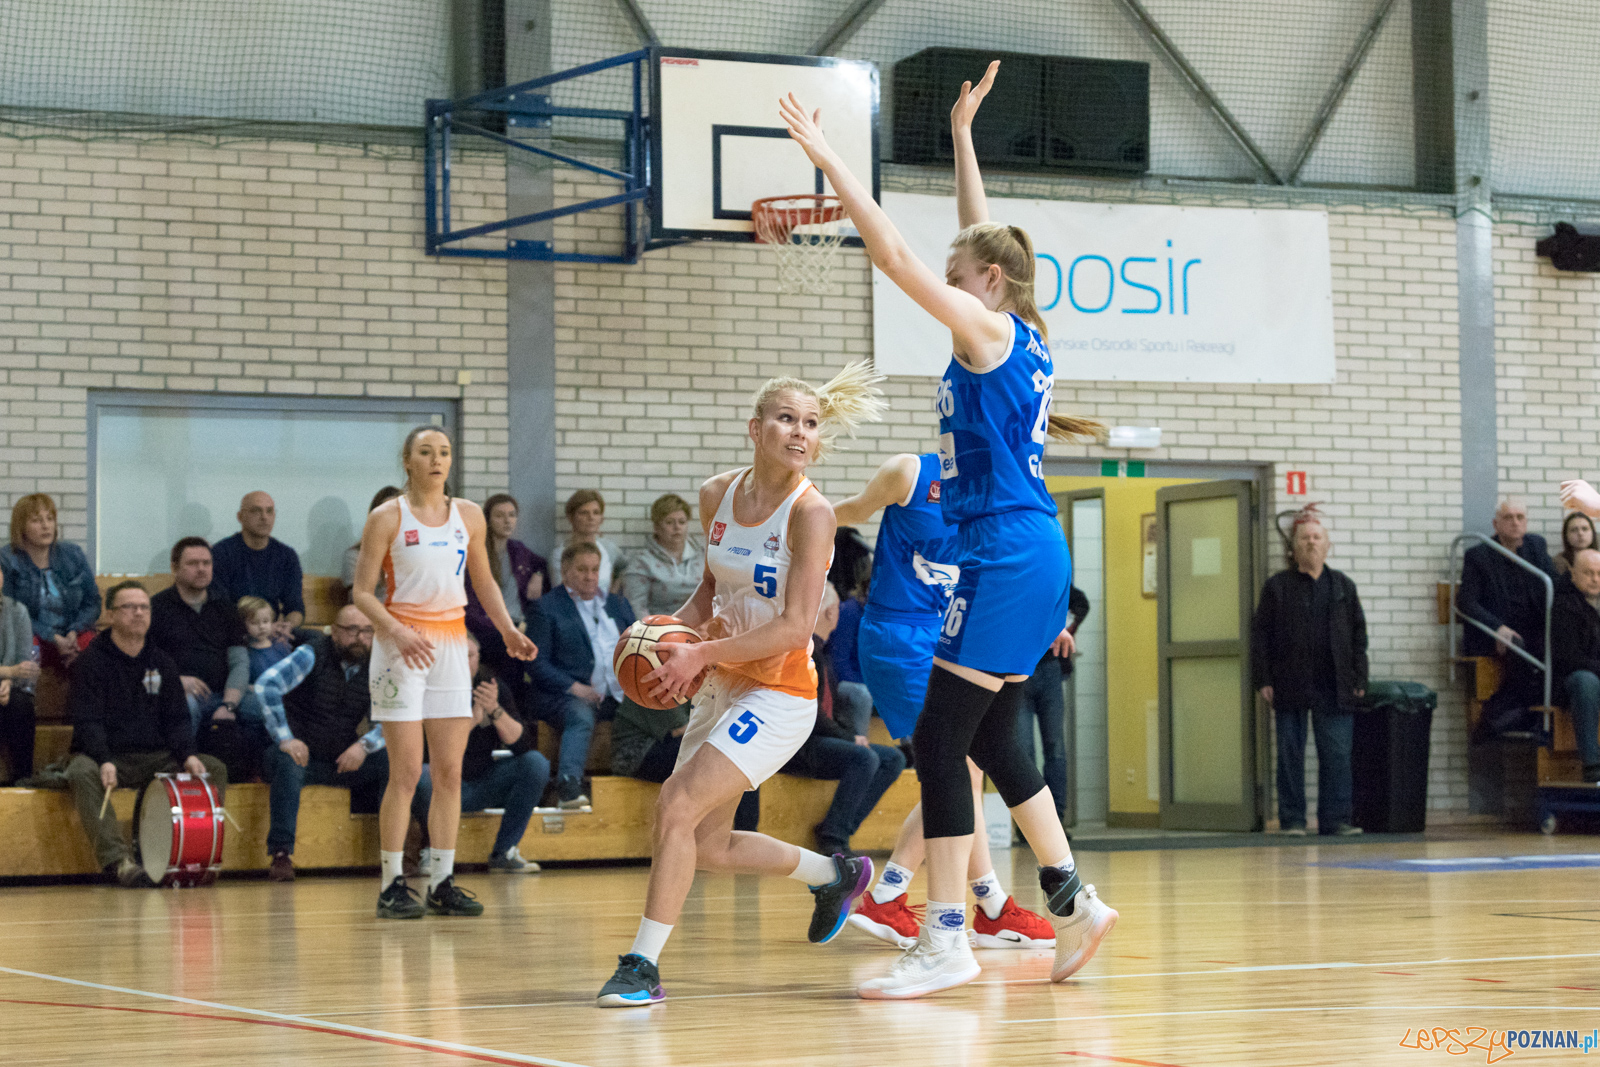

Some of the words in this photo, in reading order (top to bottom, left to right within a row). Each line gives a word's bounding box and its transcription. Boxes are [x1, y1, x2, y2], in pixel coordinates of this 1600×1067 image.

[456, 549, 465, 576] 7
[753, 563, 778, 599] 5
[728, 710, 765, 745] 5
